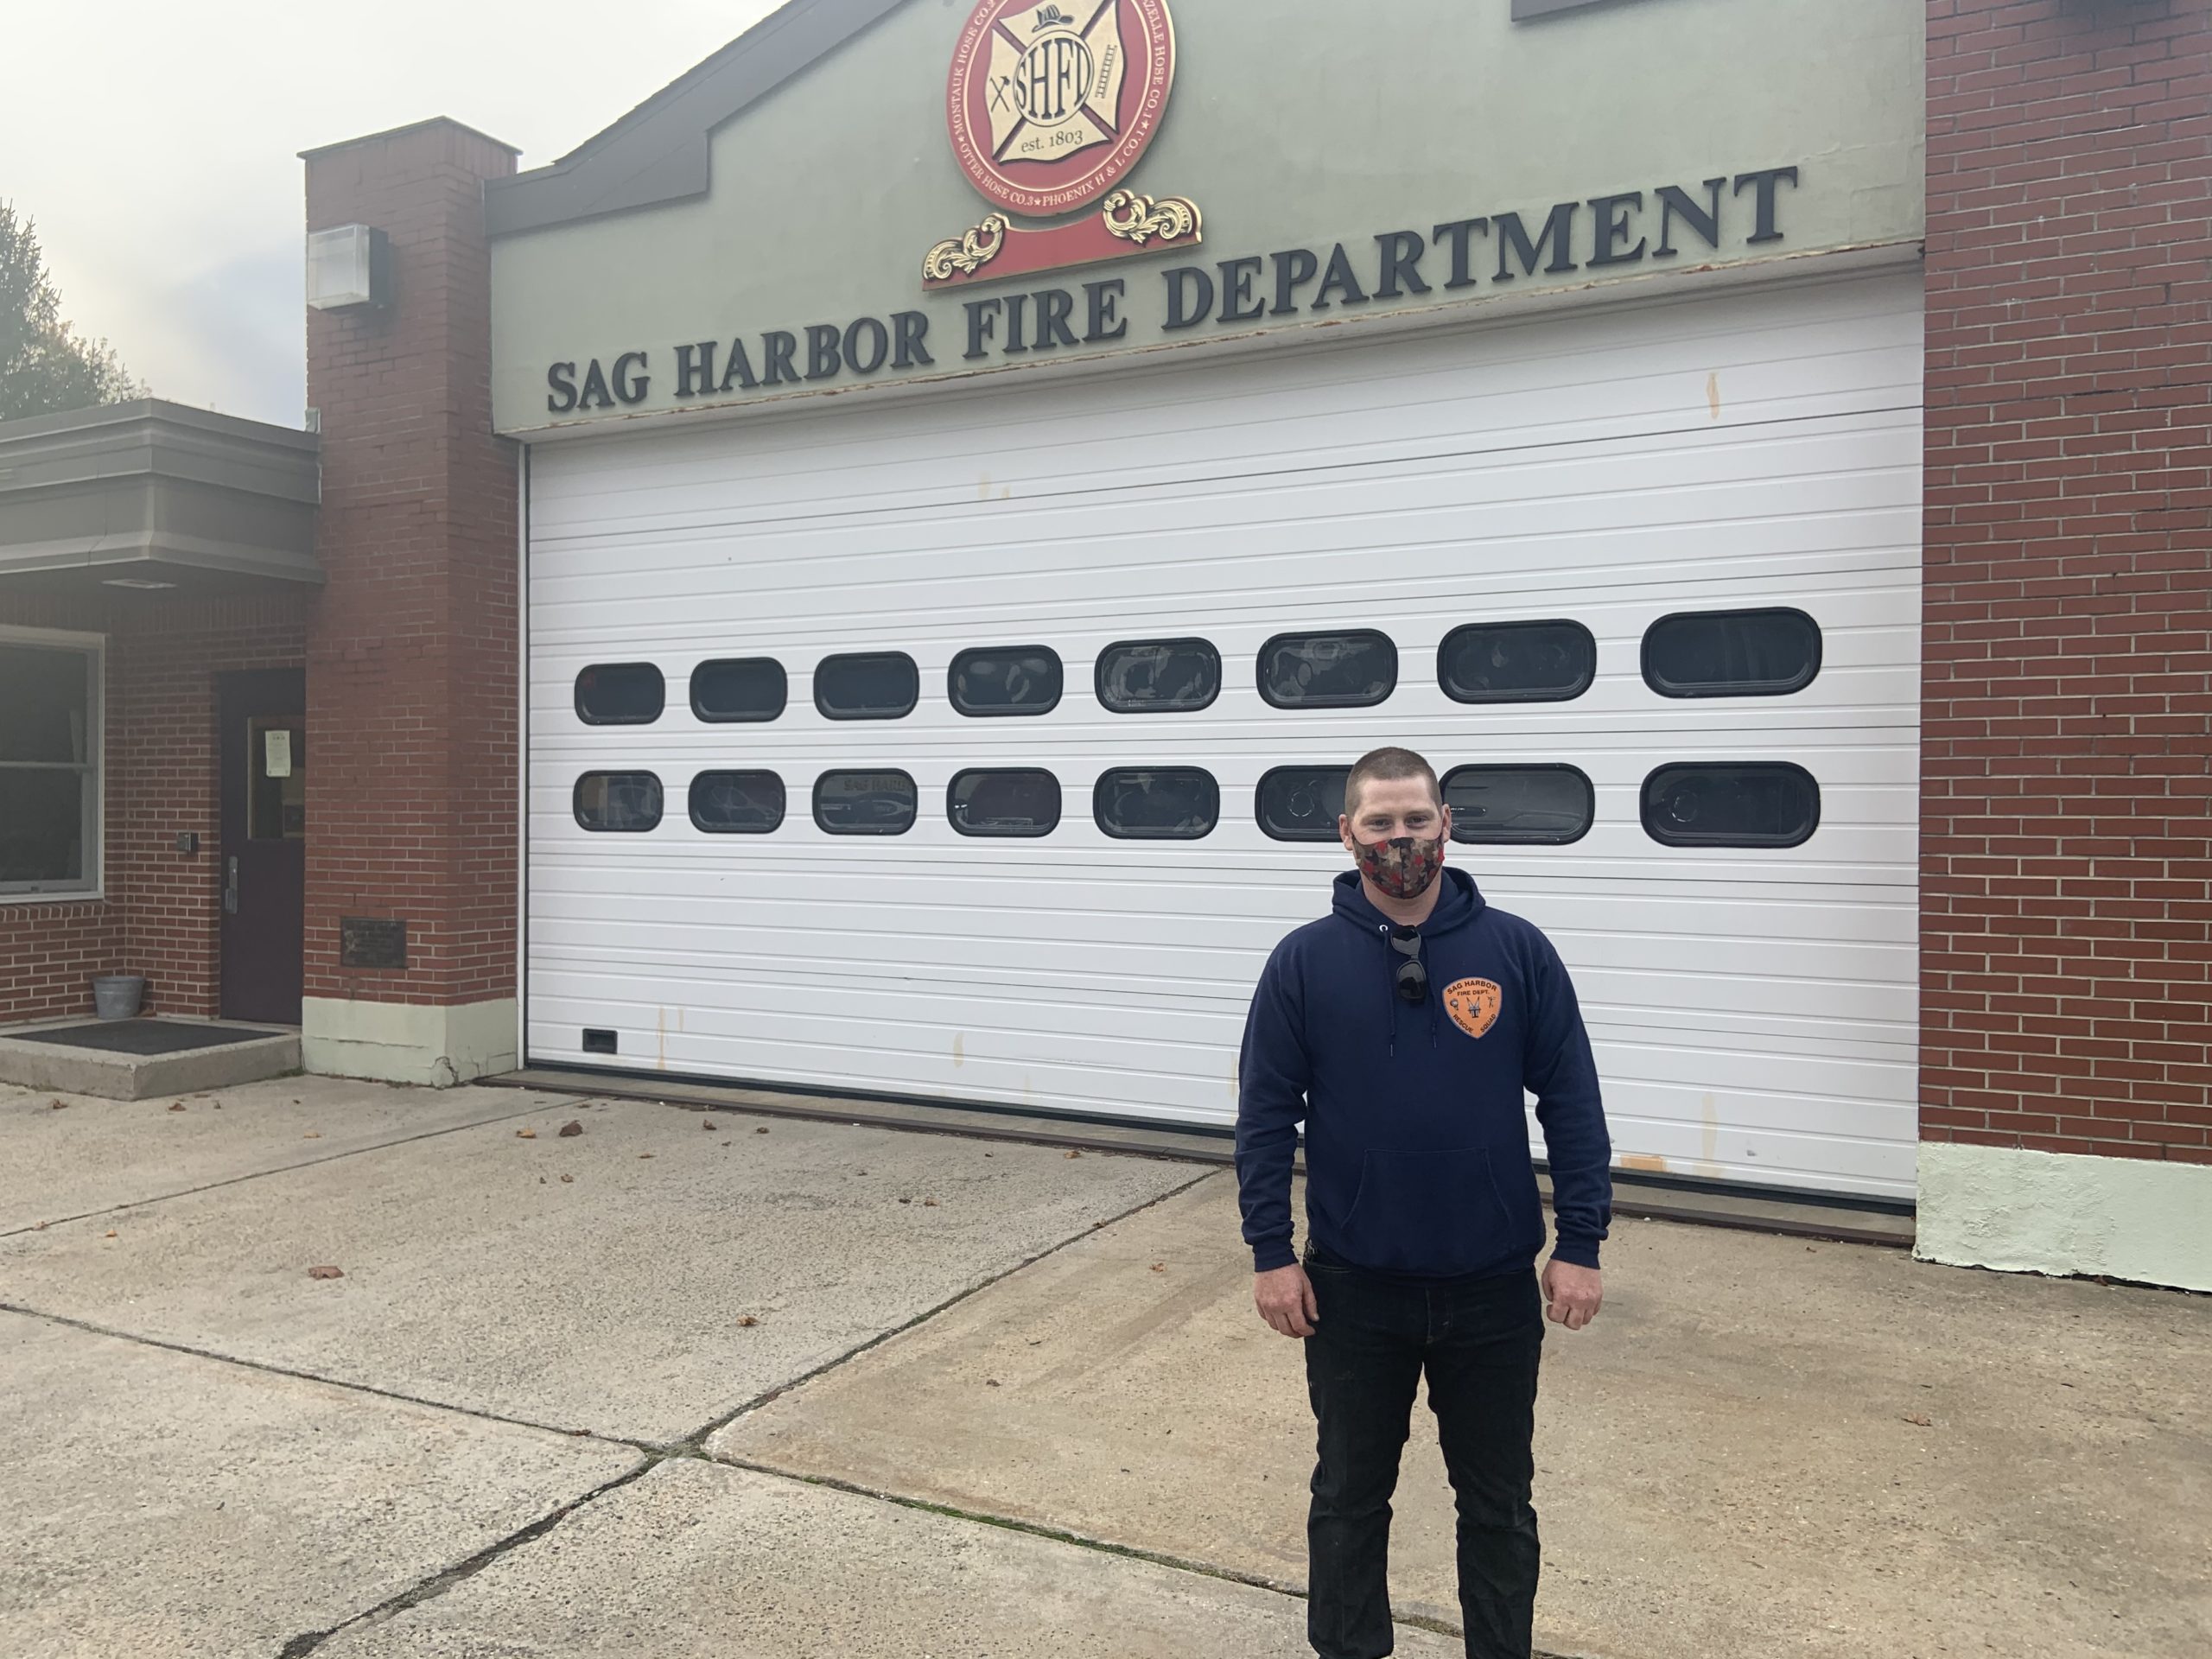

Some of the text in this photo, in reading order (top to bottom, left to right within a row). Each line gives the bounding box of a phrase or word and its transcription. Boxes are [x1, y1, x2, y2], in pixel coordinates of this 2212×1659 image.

[957, 27, 978, 64] HOSE
[1153, 46, 1166, 85] HOSE
[951, 67, 965, 135] MONTAUK
[1021, 130, 1084, 152] est. 1803
[960, 143, 985, 179] OTTER
[982, 175, 1010, 199] HOSE
[1042, 181, 1095, 207] PHOENIX
[1095, 172, 1106, 186] H
[1106, 166, 1116, 177] &
[1115, 156, 1125, 167] L
[546, 164, 1799, 412] SAG HARBOR FIRE DEPARTMENT
[1446, 979, 1498, 995] SAG HARBOR
[1452, 1014, 1497, 1033] RESCUE SQUAD
